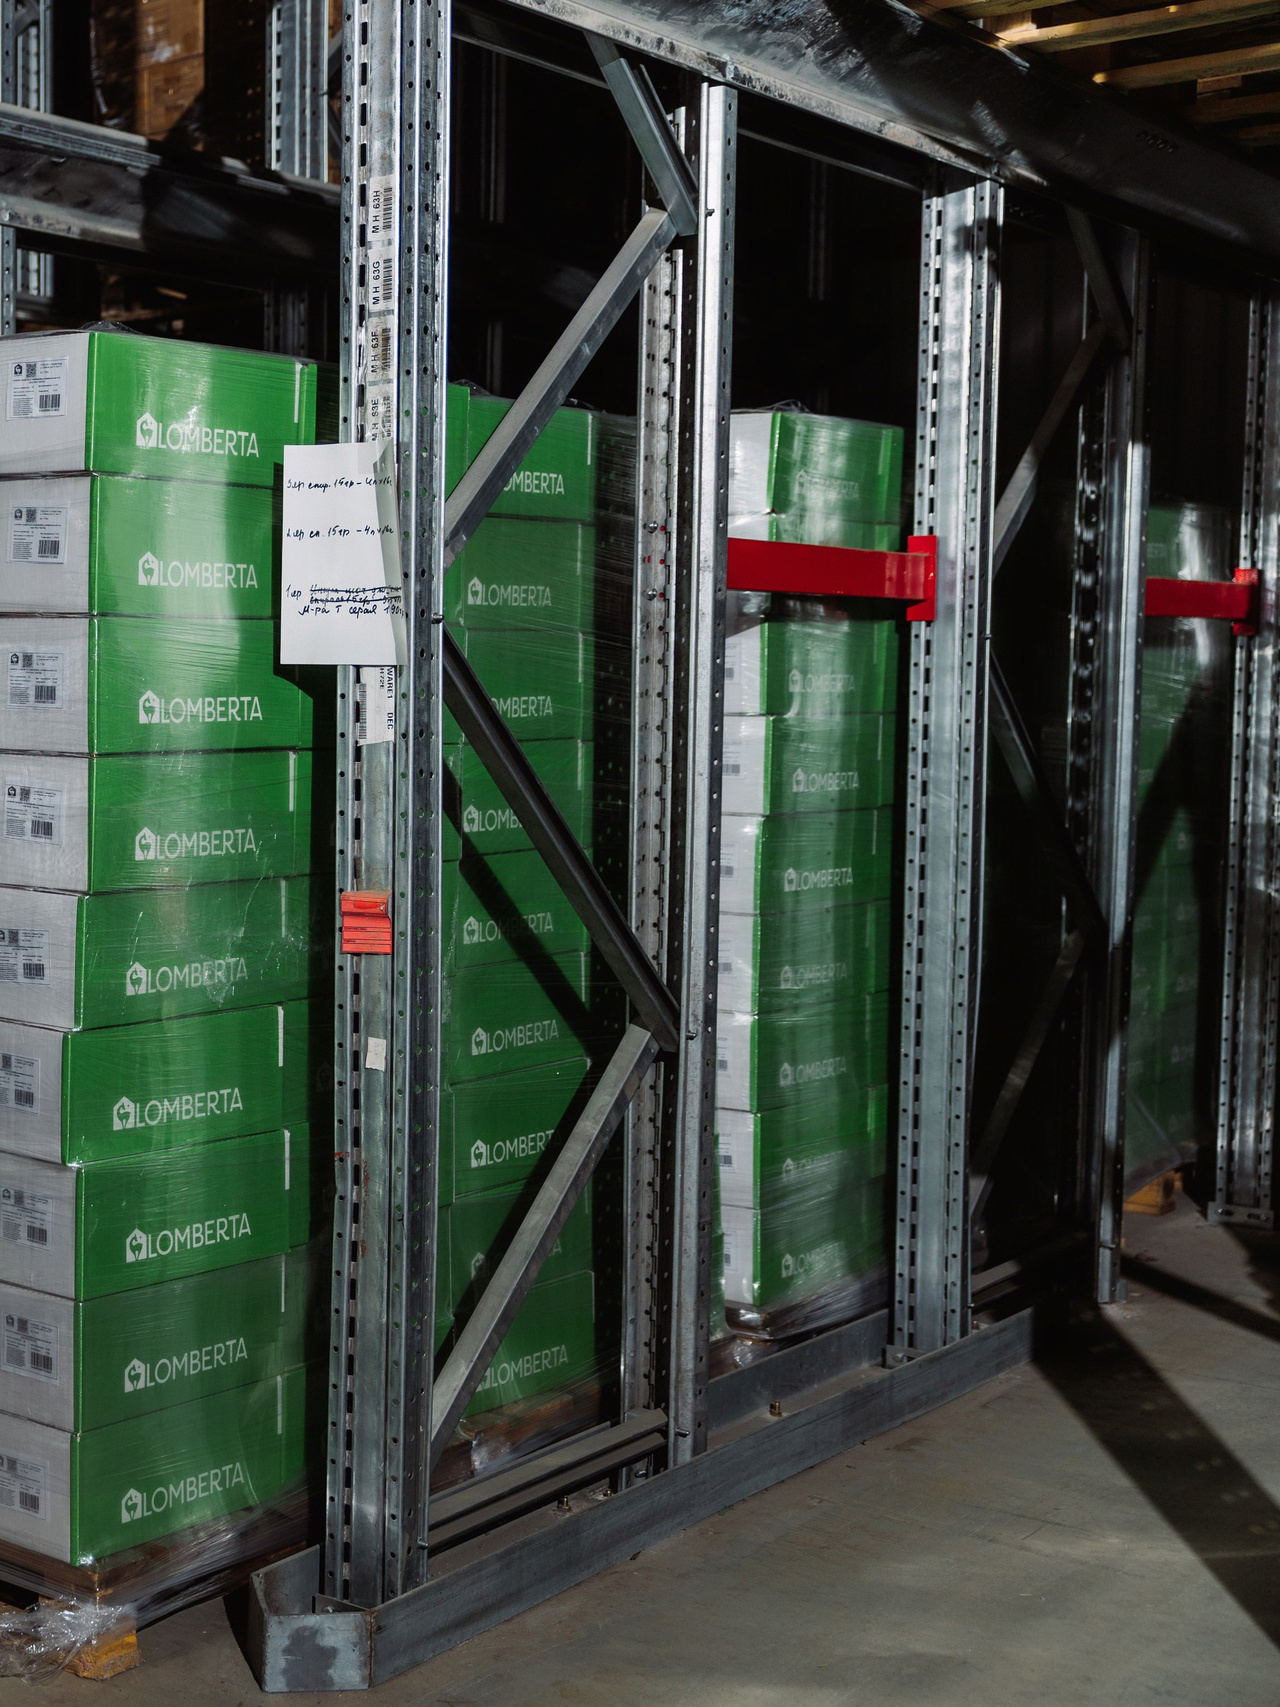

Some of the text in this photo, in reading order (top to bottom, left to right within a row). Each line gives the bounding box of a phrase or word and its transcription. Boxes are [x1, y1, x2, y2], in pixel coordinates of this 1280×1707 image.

[372, 190, 380, 209] 63H
[372, 260, 380, 280] 63G
[157, 422, 259, 457] LOMBERTA
[503, 471, 565, 495] MBERTA
[158, 563, 258, 588] LOMBERTA
[482, 584, 552, 607] LOMBERTA
[161, 696, 262, 723] LOMBERTA
[490, 696, 553, 718] MBERTA
[804, 771, 859, 794] LOMBERTA
[478, 808, 523, 832] LOMB
[156, 829, 257, 859] LOMBERTA
[796, 867, 854, 891] LOMBERTA
[147, 957, 249, 993] LOMBERTA
[487, 1019, 559, 1053] LOMBERTA
[135, 1087, 243, 1126] LOMBERTA
[148, 1212, 251, 1258] LOMBERTA
[146, 1337, 248, 1387] LOMBERTA
[490, 1344, 569, 1387] LOMBERTA
[143, 1461, 244, 1516] LOMBERTA
